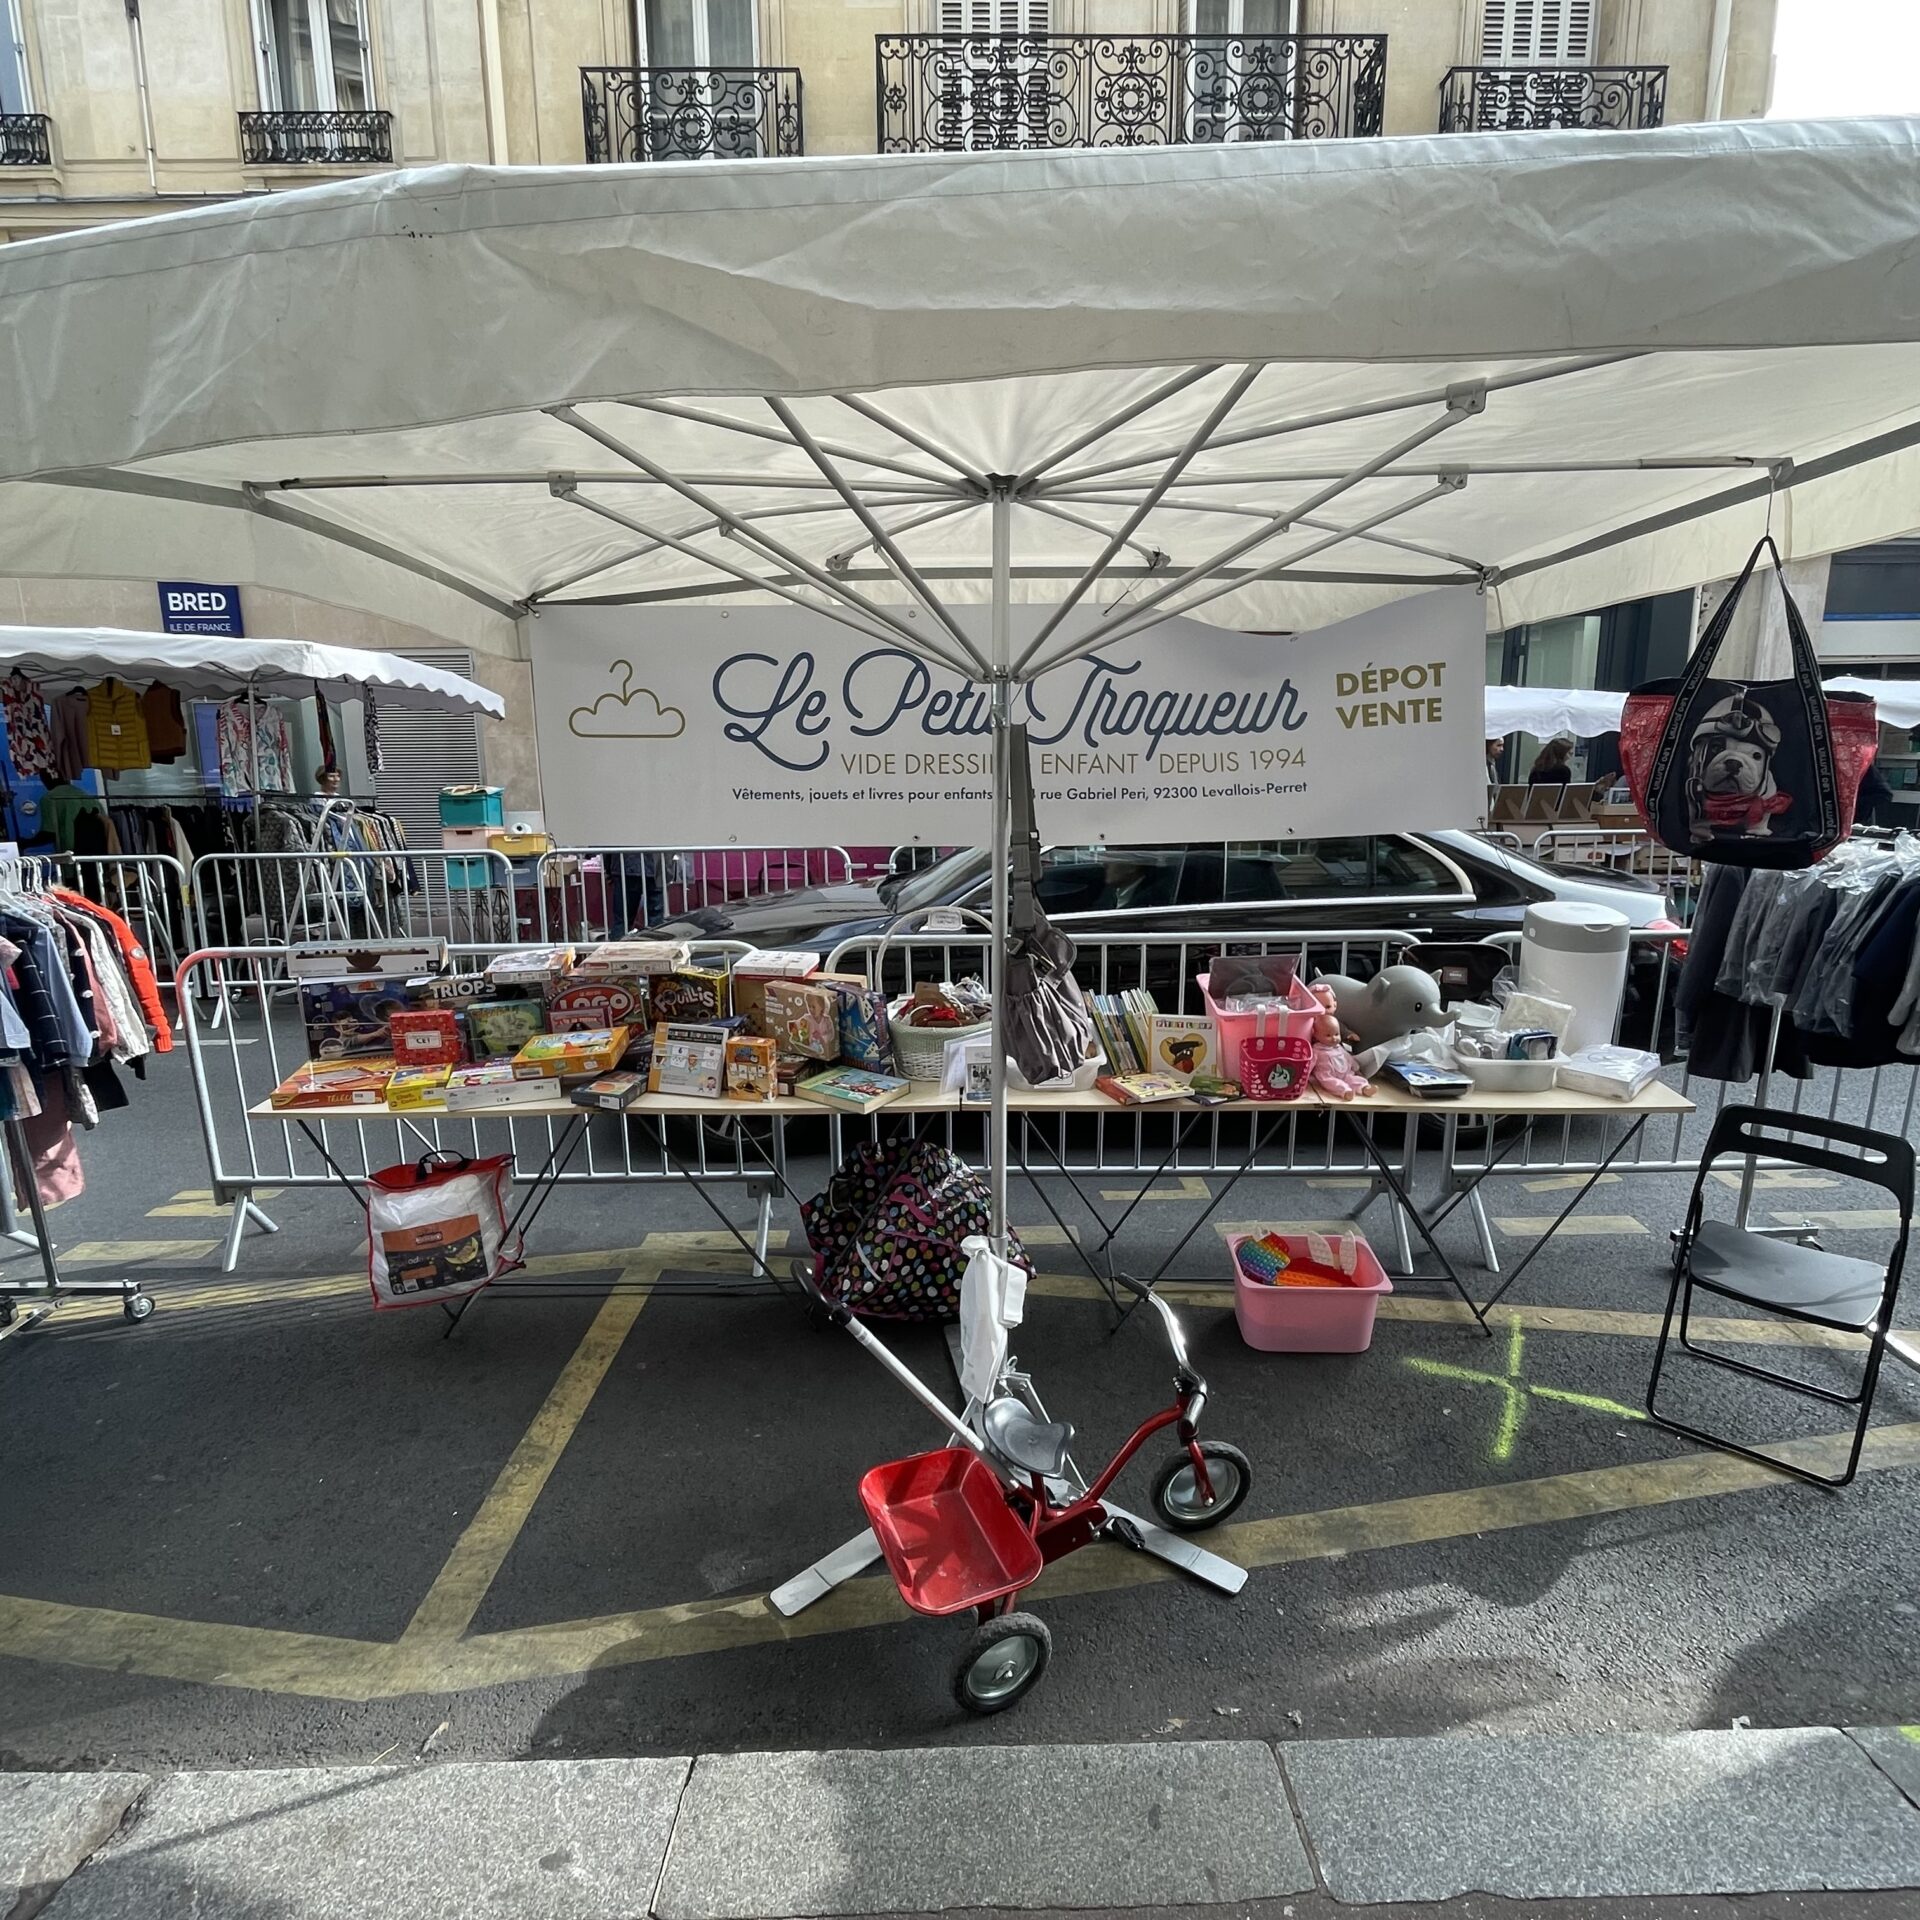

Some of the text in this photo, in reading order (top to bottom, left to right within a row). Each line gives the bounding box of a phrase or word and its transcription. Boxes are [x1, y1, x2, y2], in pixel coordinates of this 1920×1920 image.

[167, 592, 227, 611] BRED
[169, 623, 232, 632] ILE DE FRANCE
[1335, 661, 1446, 697] DÉPOT
[712, 648, 1308, 772] Le Peti Troqueur
[1335, 697, 1443, 730] VENTE
[840, 747, 1307, 776] VIDE DRESSI ENFANT DEPUIS 1994
[732, 787, 993, 804] Vêtements, jouets et livres pour enfants
[1040, 790, 1062, 800] rue
[1066, 786, 1117, 800] Gabriel
[1153, 786, 1198, 800] 92300
[1202, 781, 1307, 797] Levallois-Perret
[429, 980, 497, 999] TRIOPS
